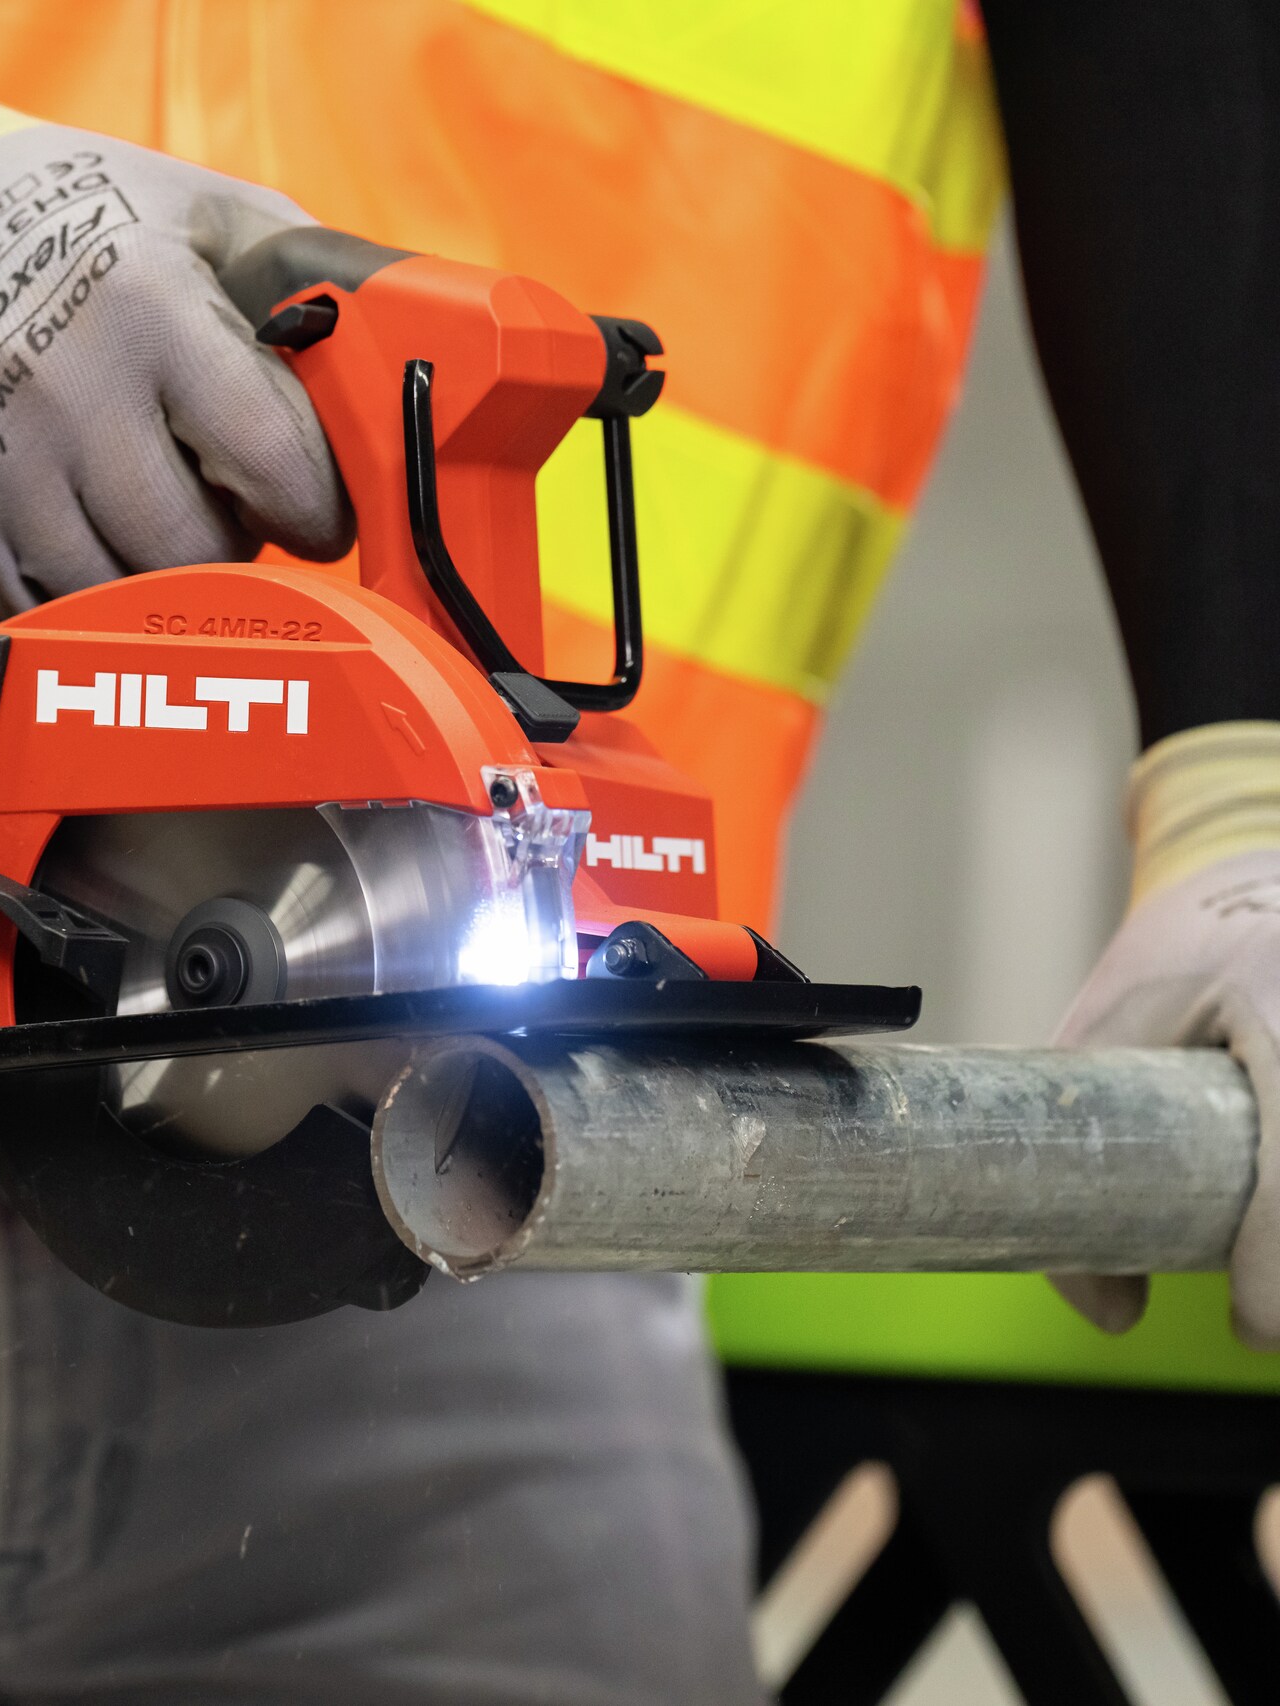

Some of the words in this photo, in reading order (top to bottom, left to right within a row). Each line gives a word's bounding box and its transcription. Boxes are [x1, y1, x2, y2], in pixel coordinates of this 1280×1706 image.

[25, 241, 119, 356] Dong
[143, 613, 188, 636] SC
[197, 616, 323, 642] 4MR-22
[35, 669, 310, 735] HILTI
[586, 832, 706, 875] HILTI
